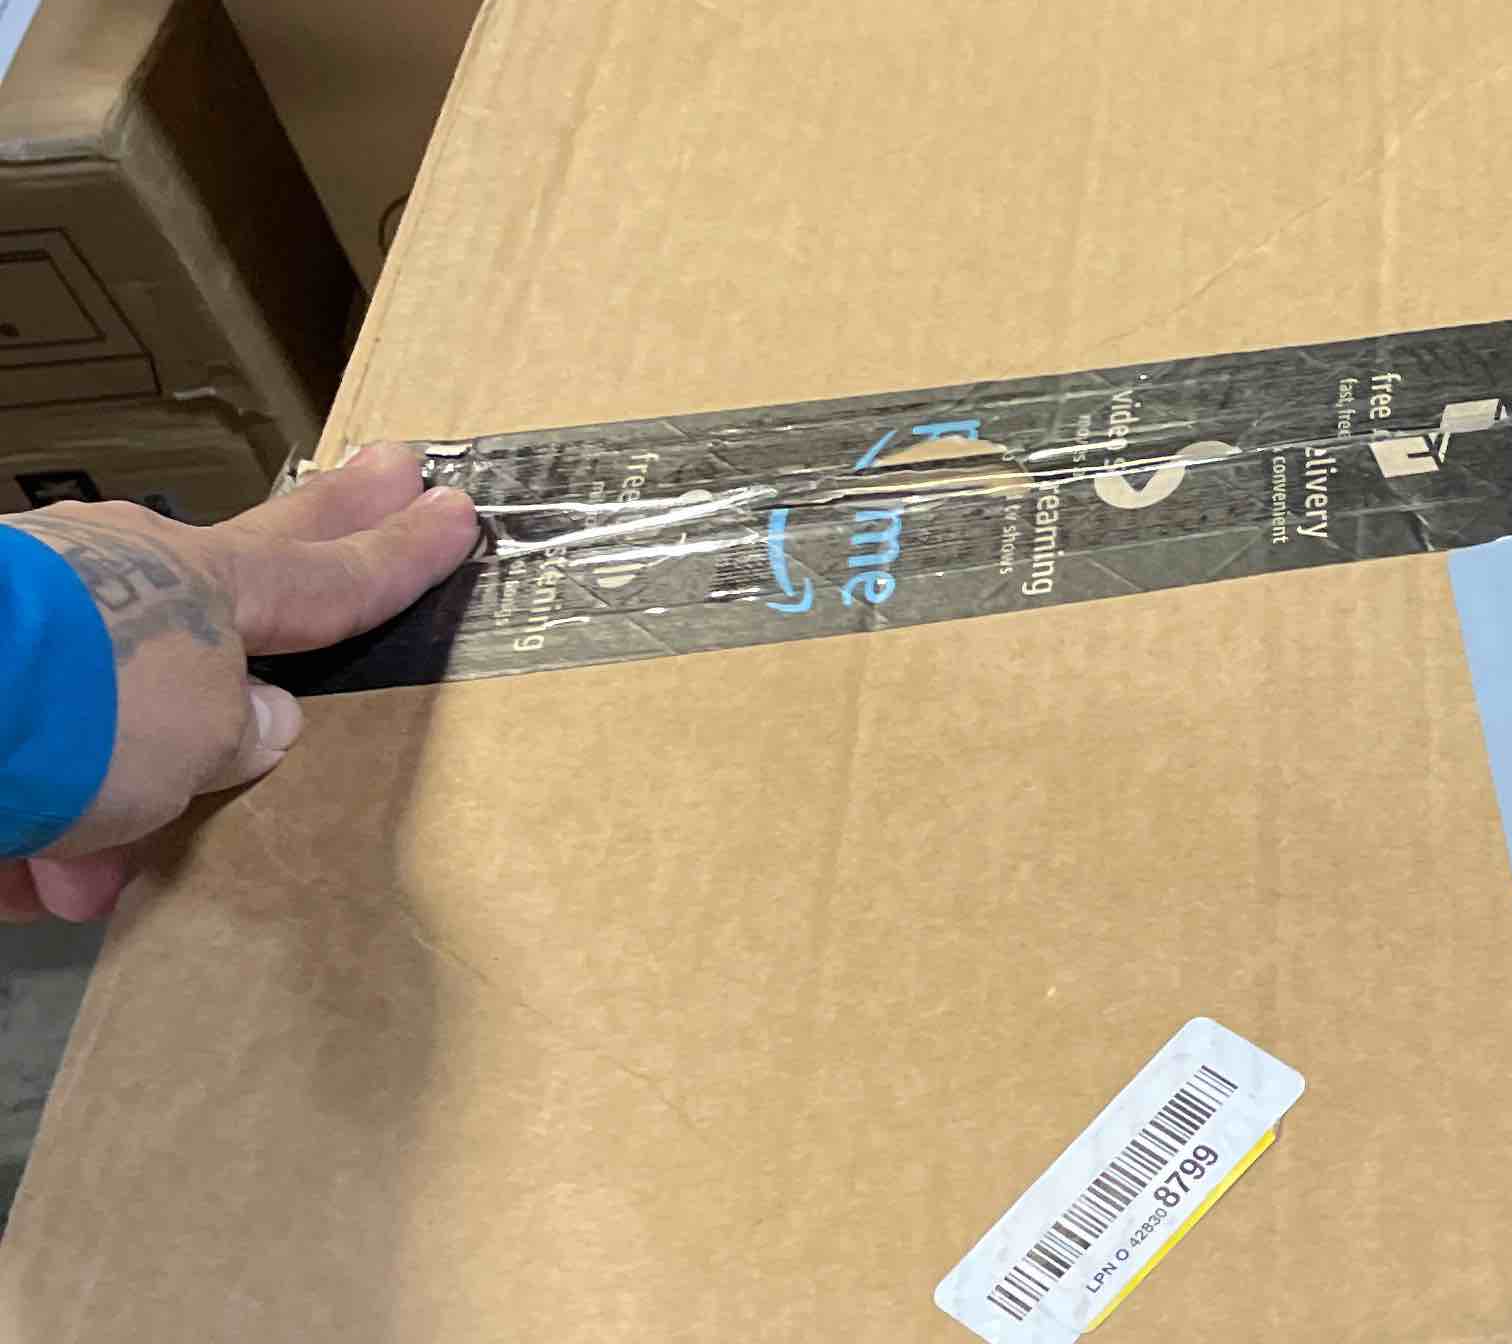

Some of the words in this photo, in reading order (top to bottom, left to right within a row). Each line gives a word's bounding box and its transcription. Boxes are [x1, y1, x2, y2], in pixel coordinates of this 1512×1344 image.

[1368, 372, 1403, 421] free
[1269, 458, 1291, 546] convenient
[998, 525, 1020, 575] shows
[1085, 1260, 1119, 1295] LPN
[1127, 1206, 1169, 1249] 42830
[1152, 1143, 1219, 1209] 8799
